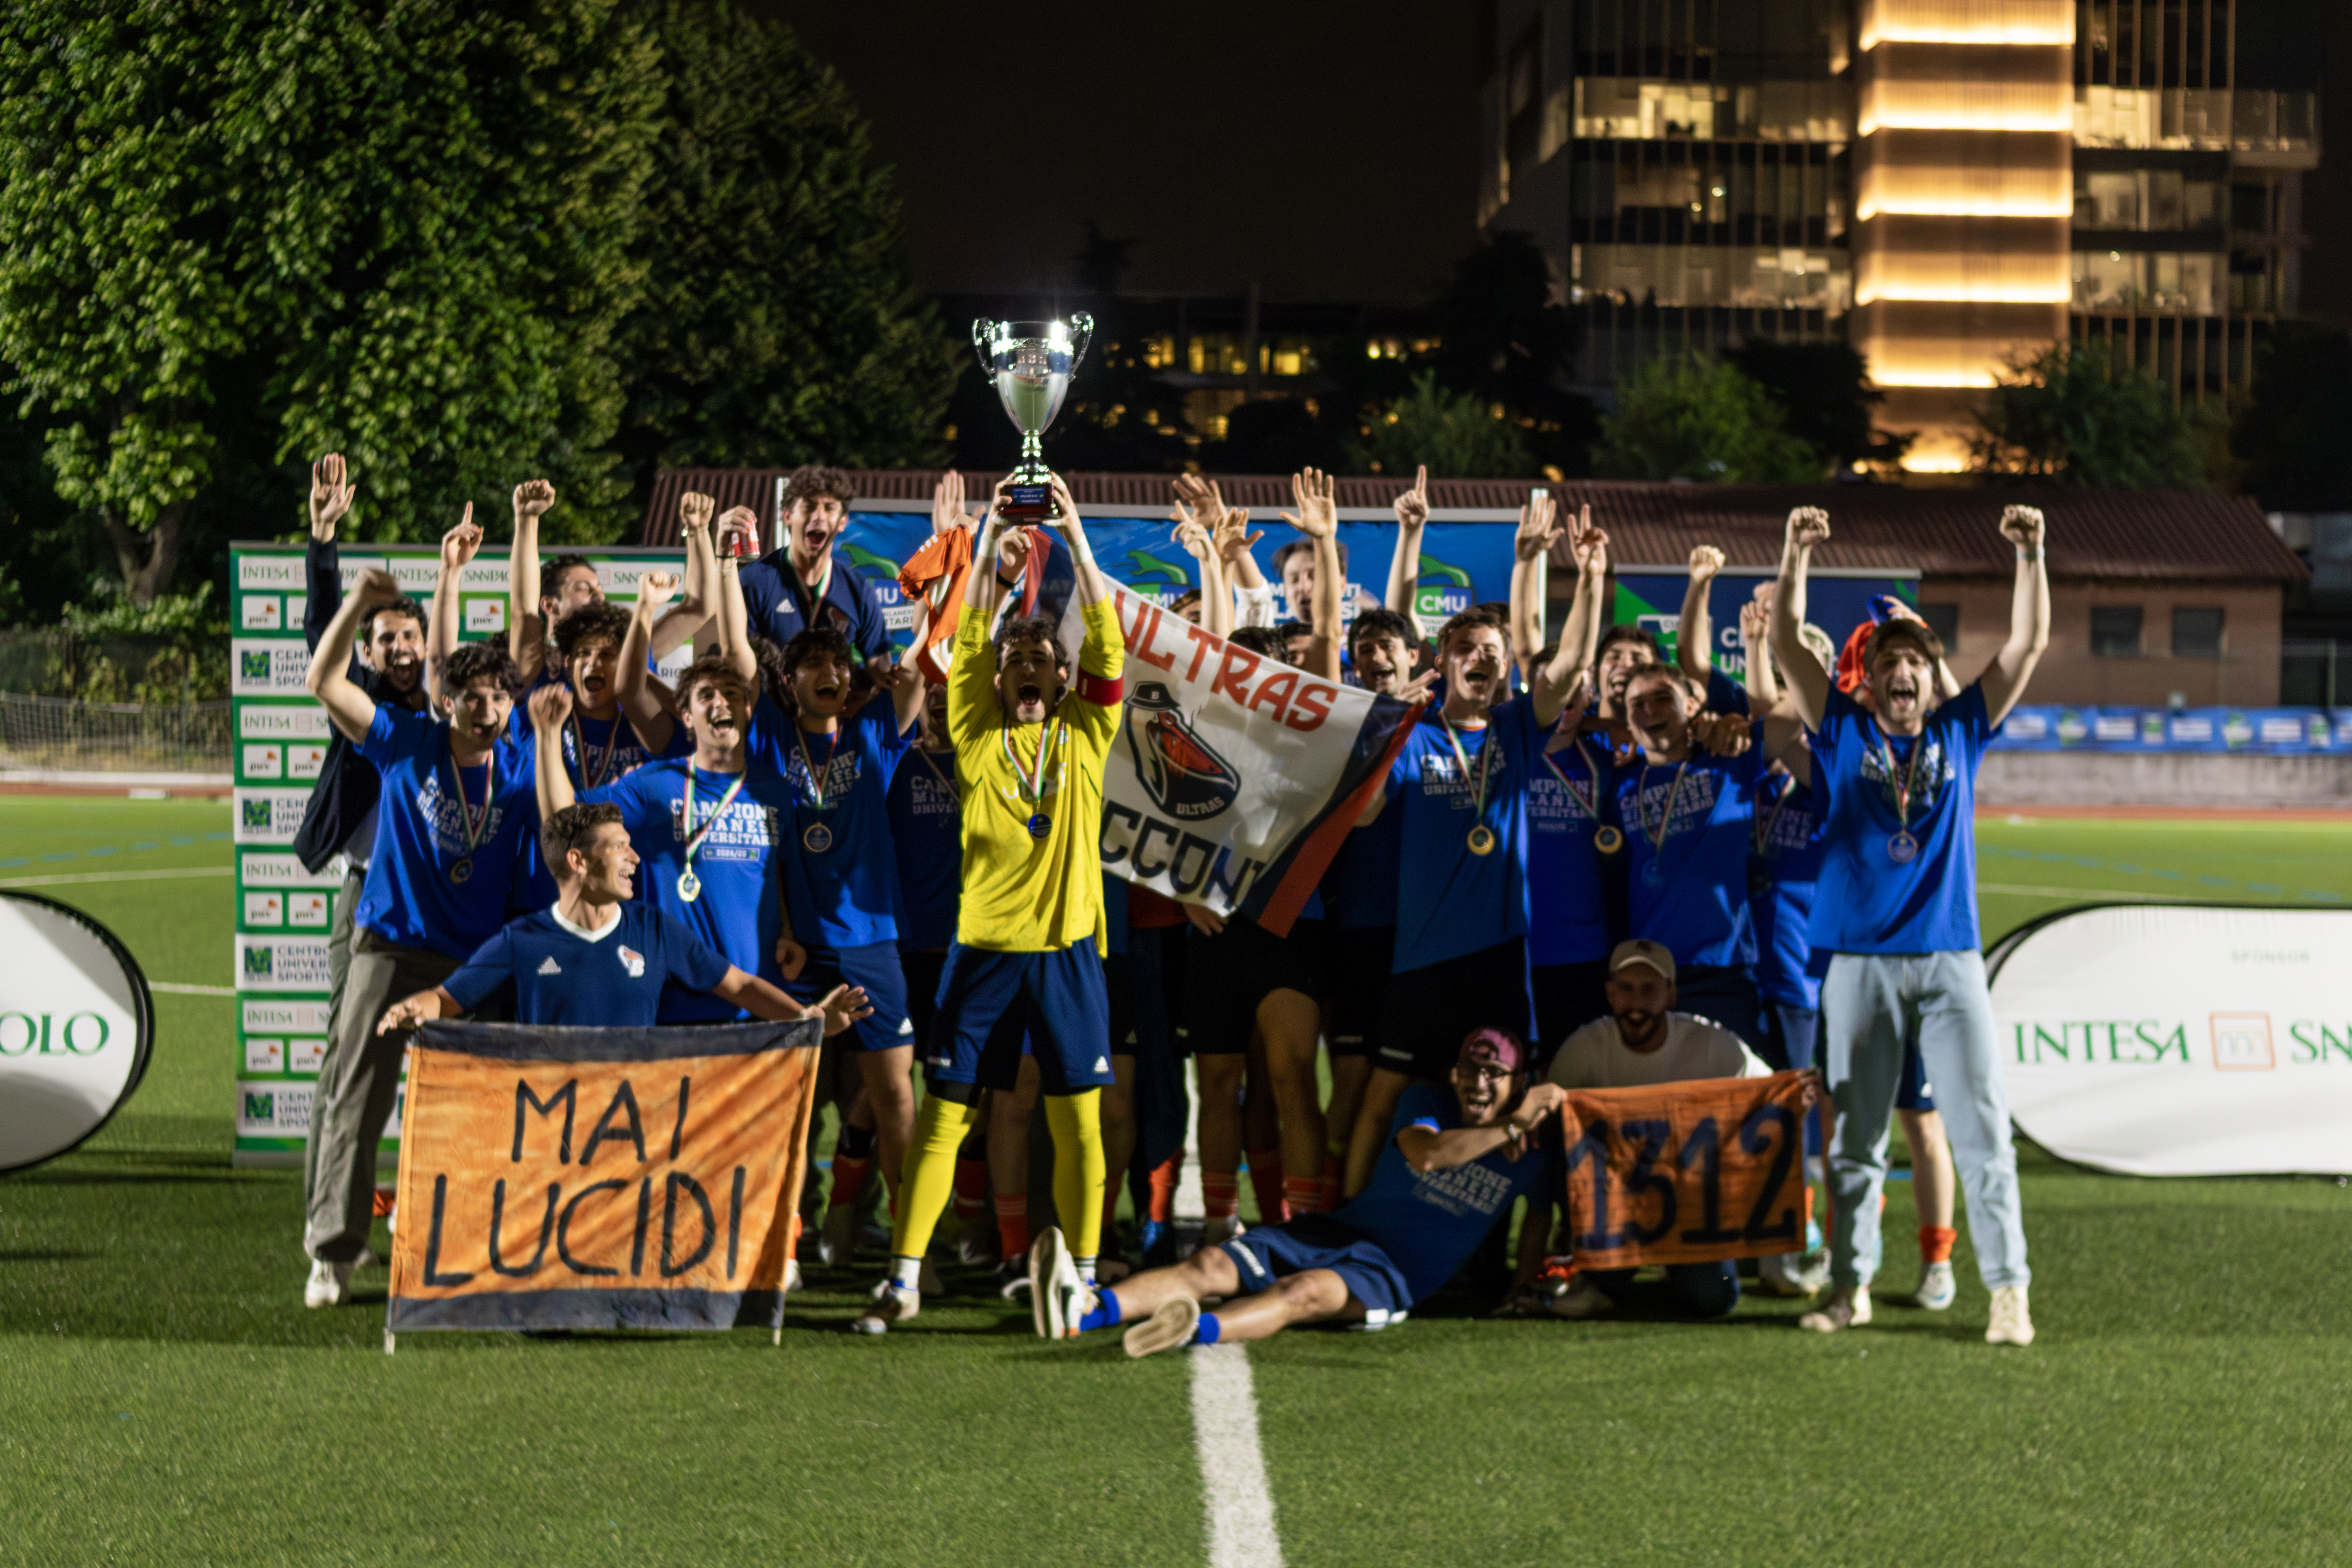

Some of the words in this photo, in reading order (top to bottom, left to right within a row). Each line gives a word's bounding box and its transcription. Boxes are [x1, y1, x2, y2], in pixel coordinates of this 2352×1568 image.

[1420, 595, 1466, 612] CMU
[1115, 589, 1339, 732] ULTRAS
[1176, 796, 1224, 815] ULTRAS
[2231, 949, 2310, 964] SPONSOR
[2013, 1020, 2192, 1063] INTESA
[512, 1075, 690, 1166] MAI
[1567, 1103, 1797, 1250] 1312
[424, 1165, 746, 1287] LUCIDI
